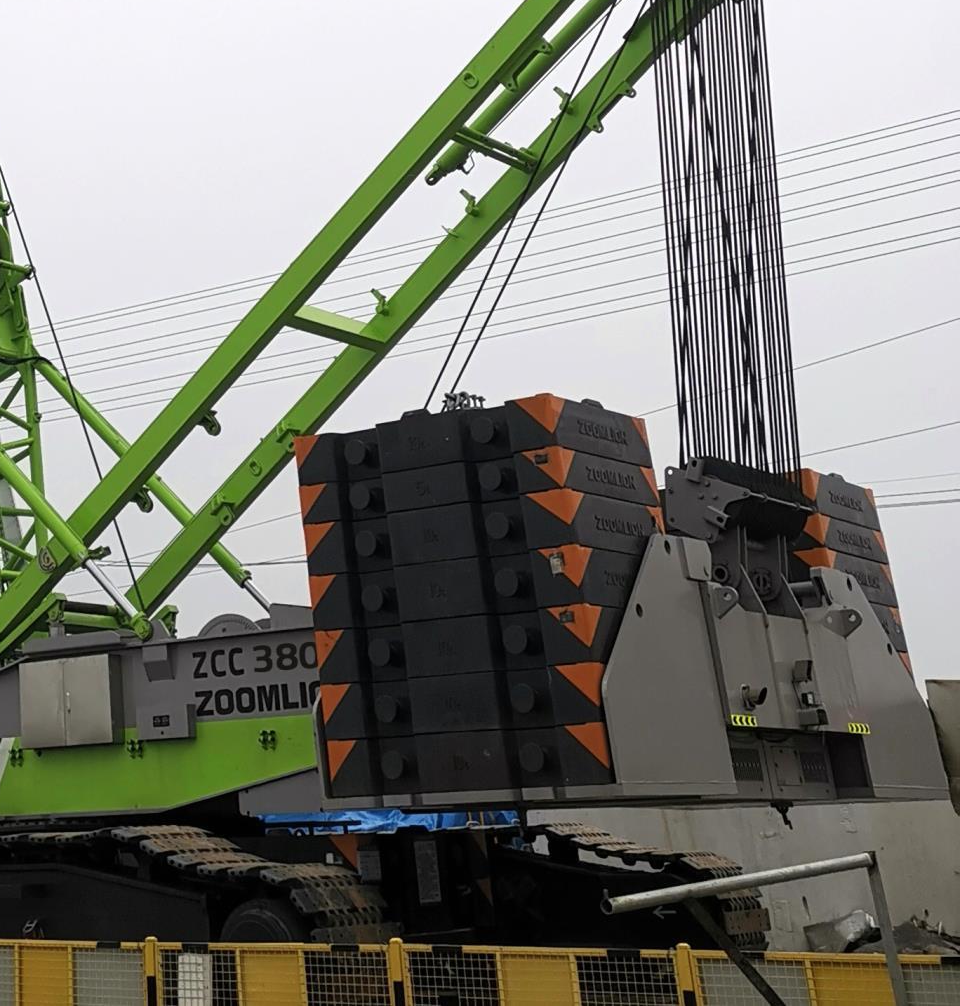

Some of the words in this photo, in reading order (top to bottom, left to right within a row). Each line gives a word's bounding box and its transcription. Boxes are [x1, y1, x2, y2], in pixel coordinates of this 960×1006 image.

[577, 419, 628, 446] ZOOMLION
[585, 466, 636, 490] ZOOMLION
[594, 515, 644, 537] ZOOMLION
[192, 647, 245, 679] ZCC
